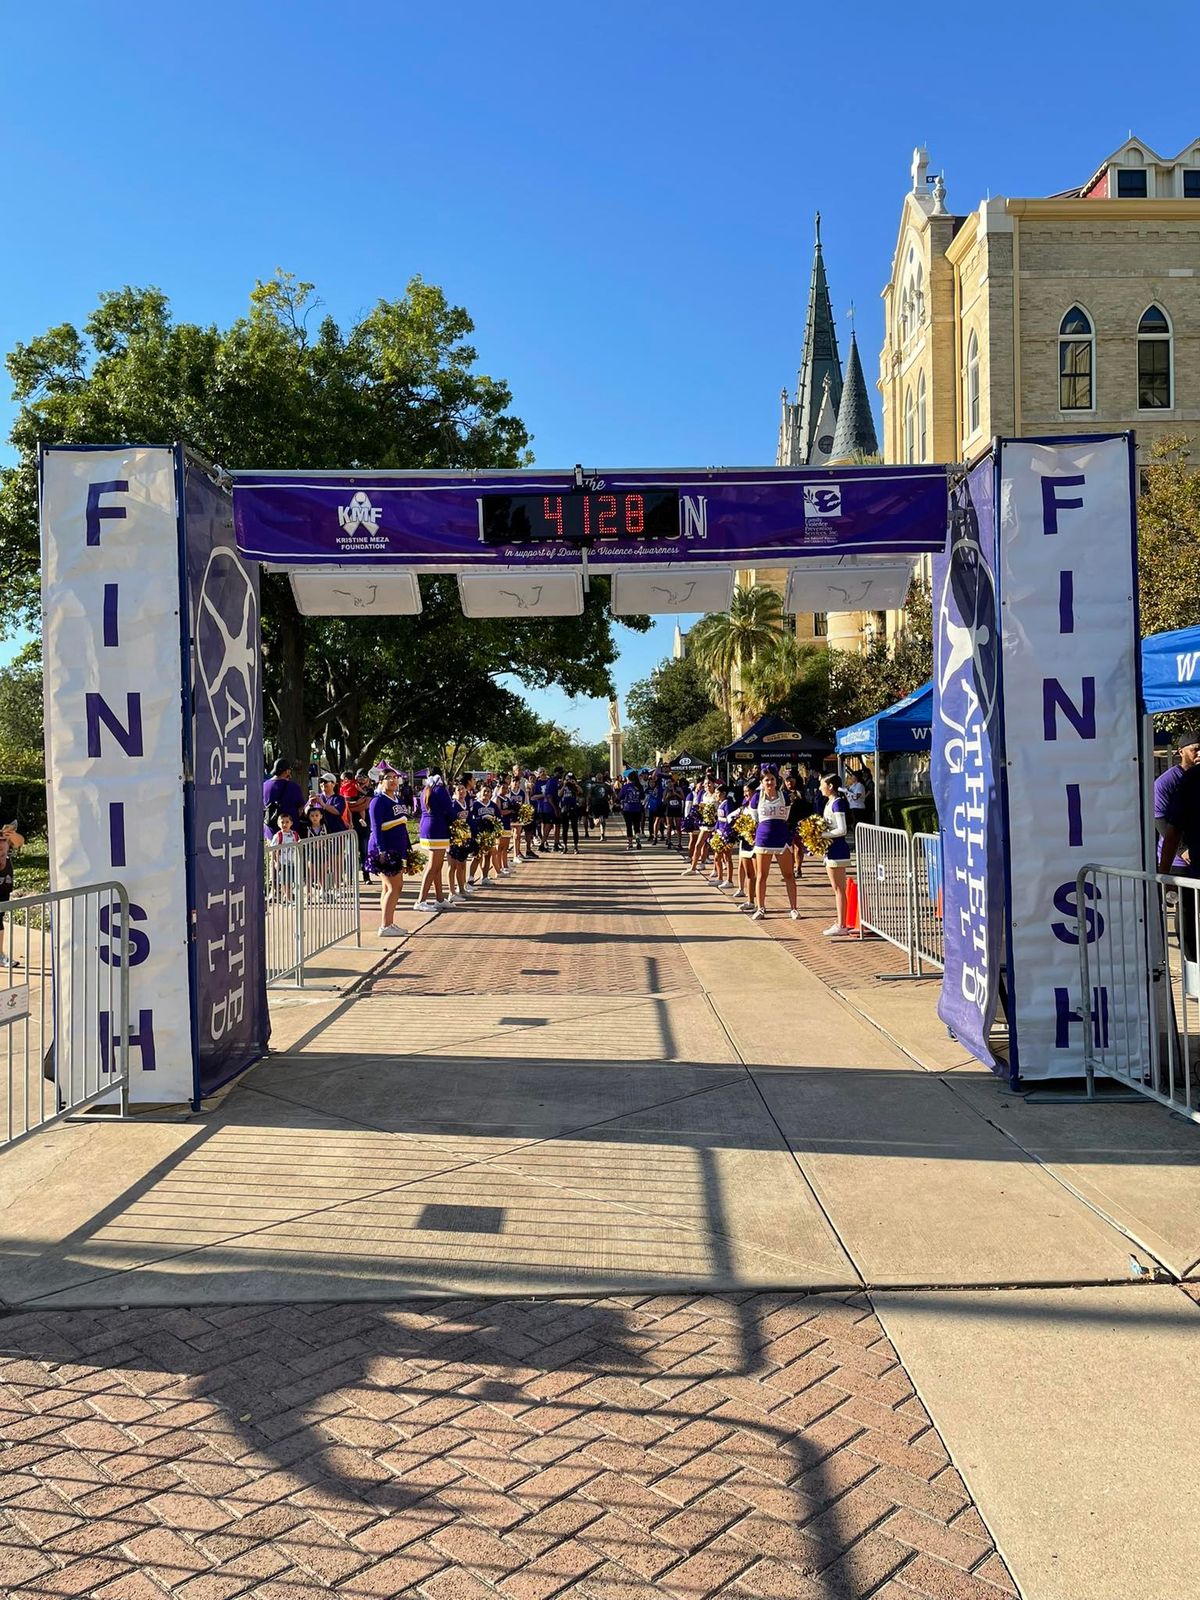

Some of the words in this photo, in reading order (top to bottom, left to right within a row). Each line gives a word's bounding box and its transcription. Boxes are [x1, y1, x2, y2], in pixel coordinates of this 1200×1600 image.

[338, 505, 383, 526] KMF
[514, 548, 546, 559] support
[546, 548, 556, 559] of
[557, 547, 596, 557] Domeic
[597, 546, 633, 555] Violence
[633, 546, 680, 556] Awareness
[86, 480, 156, 1073] FINISH
[206, 747, 228, 1041] GUILD
[223, 685, 247, 1033] ATHLETE
[944, 743, 977, 1003] GUILD
[961, 679, 987, 1016] ATHLETE
[1040, 474, 1110, 1051] FINISH
